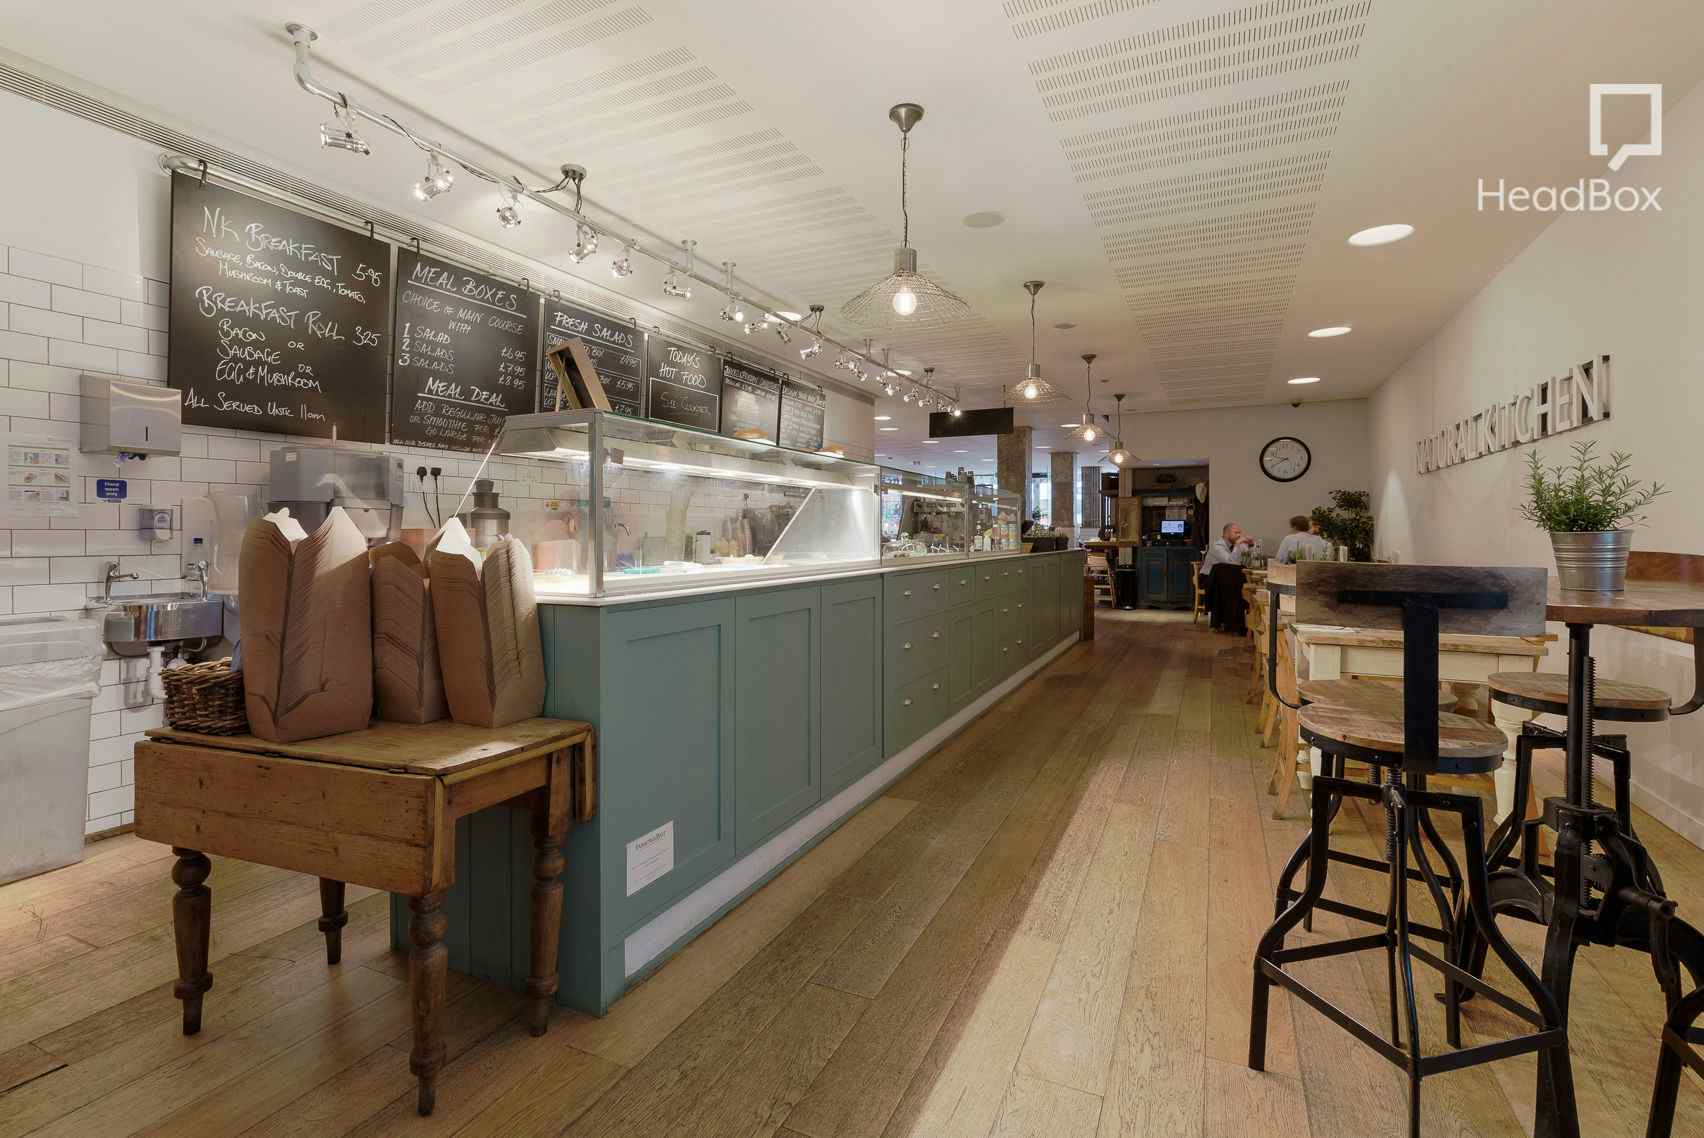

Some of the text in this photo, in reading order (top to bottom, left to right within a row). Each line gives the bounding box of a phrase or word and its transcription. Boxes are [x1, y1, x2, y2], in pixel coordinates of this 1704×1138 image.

[203, 206, 239, 241] NK
[245, 223, 342, 275] BREAKFAST
[412, 262, 518, 311] MEAL BOXES
[195, 286, 300, 328] BREAKFAST
[304, 311, 345, 340] ROLL
[401, 290, 440, 313] CHOICE
[488, 315, 524, 335] COURSE
[448, 319, 472, 335] WITH
[219, 319, 305, 352] BACON OR
[401, 323, 410, 338] 1
[414, 326, 450, 344] SALAD
[554, 312, 634, 347] FRESH SALADS
[216, 340, 314, 377] SAUSAGE OR
[399, 353, 410, 366] 3
[401, 339, 410, 350] 2
[413, 341, 455, 361] SALADS
[216, 359, 243, 385] EGG
[257, 368, 322, 393] MUSHROOM
[424, 377, 505, 407] MEAL DEAL
[659, 363, 677, 378] HOT
[681, 371, 707, 388] FOOD
[184, 388, 209, 408] ALL
[214, 392, 263, 415] SERVED
